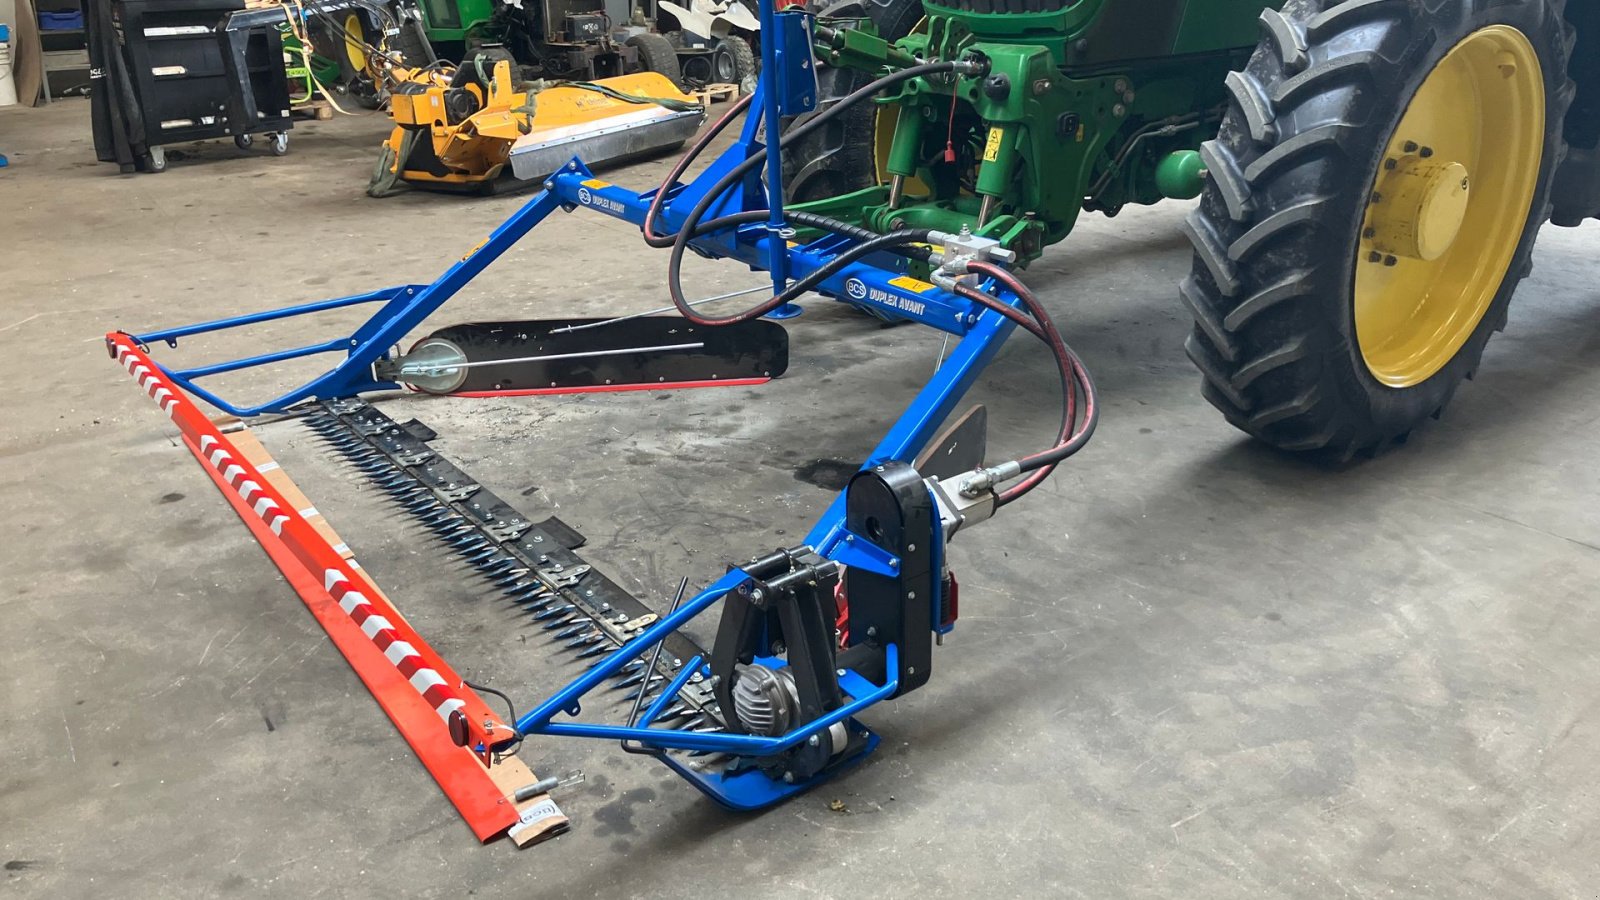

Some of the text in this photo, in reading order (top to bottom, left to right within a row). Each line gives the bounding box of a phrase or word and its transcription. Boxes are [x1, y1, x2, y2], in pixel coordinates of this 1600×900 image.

[578, 189, 590, 202] BCS
[592, 195, 610, 209] DUPLEX
[847, 280, 866, 297] BCS
[869, 287, 926, 316] DUPLEX AVANT
